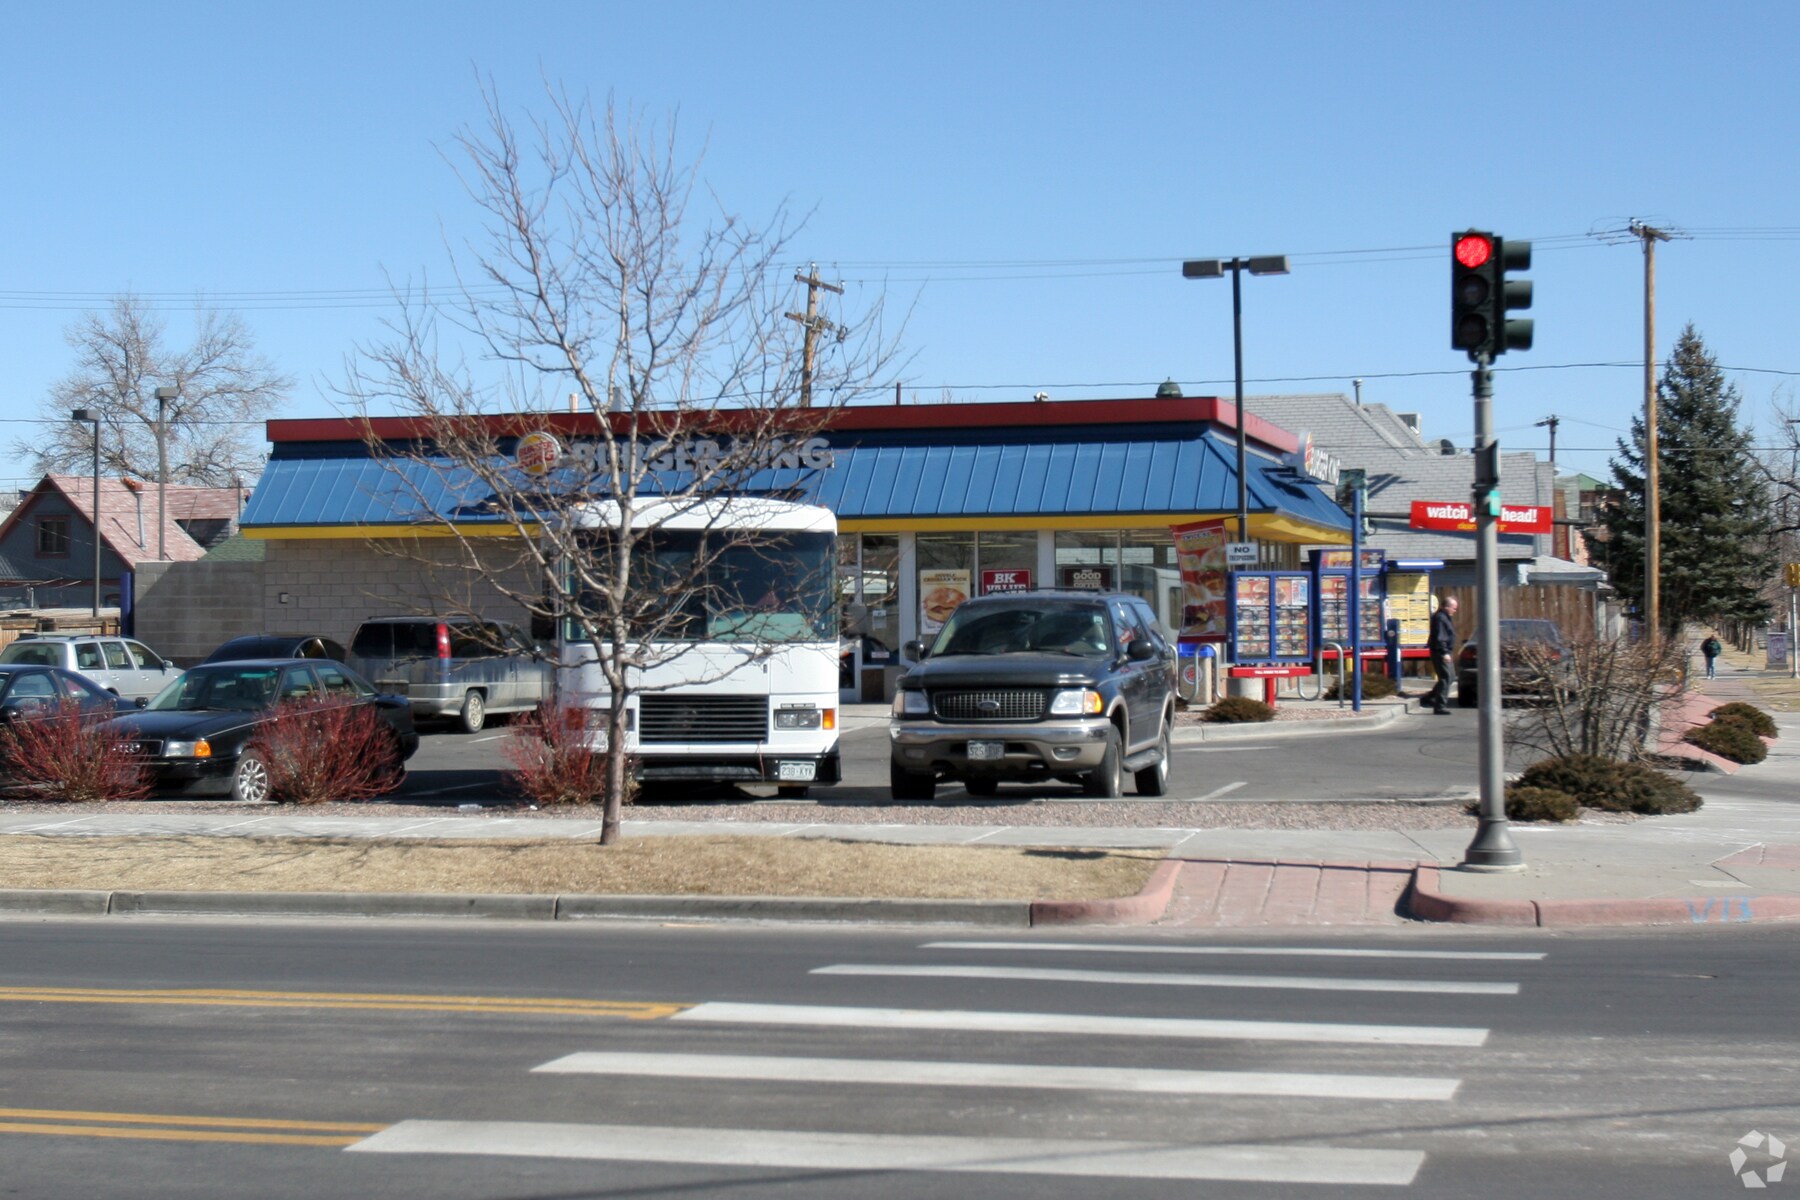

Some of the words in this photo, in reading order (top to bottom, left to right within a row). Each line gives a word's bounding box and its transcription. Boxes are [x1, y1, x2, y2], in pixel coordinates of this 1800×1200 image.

[571, 440, 719, 473] BURGER
[1427, 505, 1469, 519] watch
[1501, 508, 1538, 523] head!
[994, 573, 1017, 584] BK
[1073, 572, 1102, 580] GOOD
